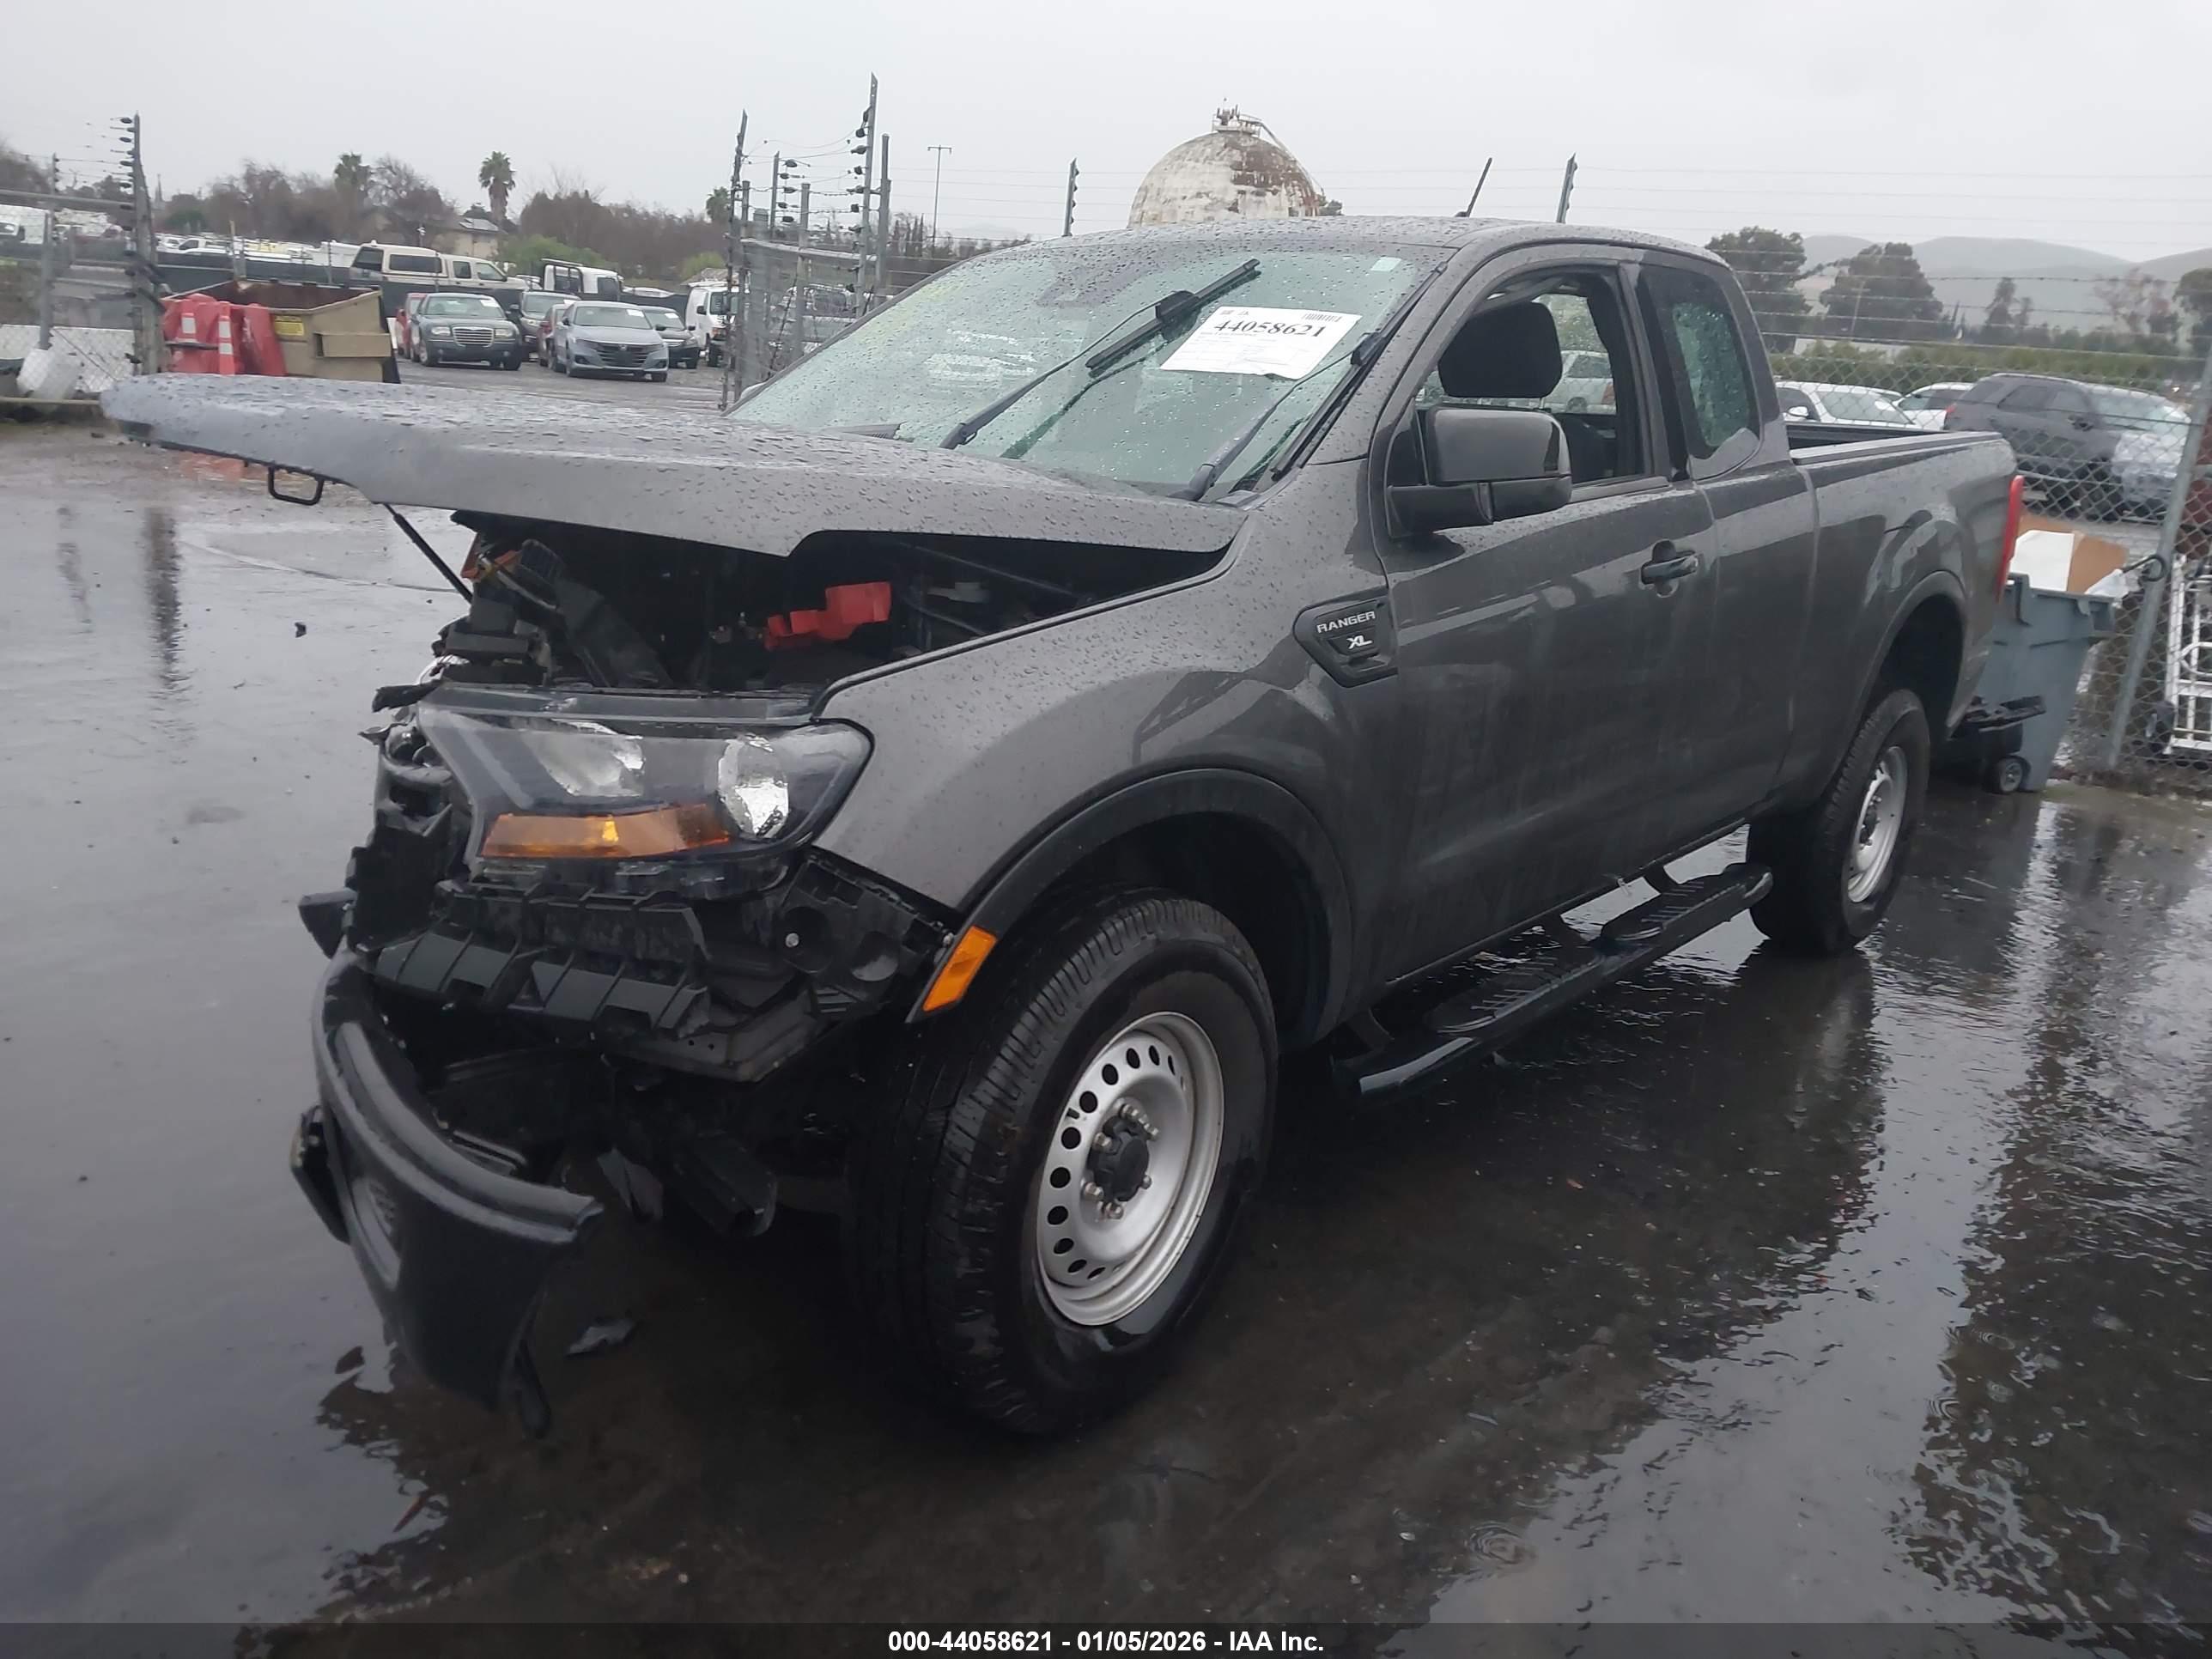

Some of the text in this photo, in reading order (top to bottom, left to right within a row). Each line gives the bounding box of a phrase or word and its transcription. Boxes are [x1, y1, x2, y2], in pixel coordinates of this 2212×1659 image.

[1213, 319, 1326, 337] 44058621
[1316, 611, 1376, 634] RANGER
[1346, 635, 1373, 650] XL
